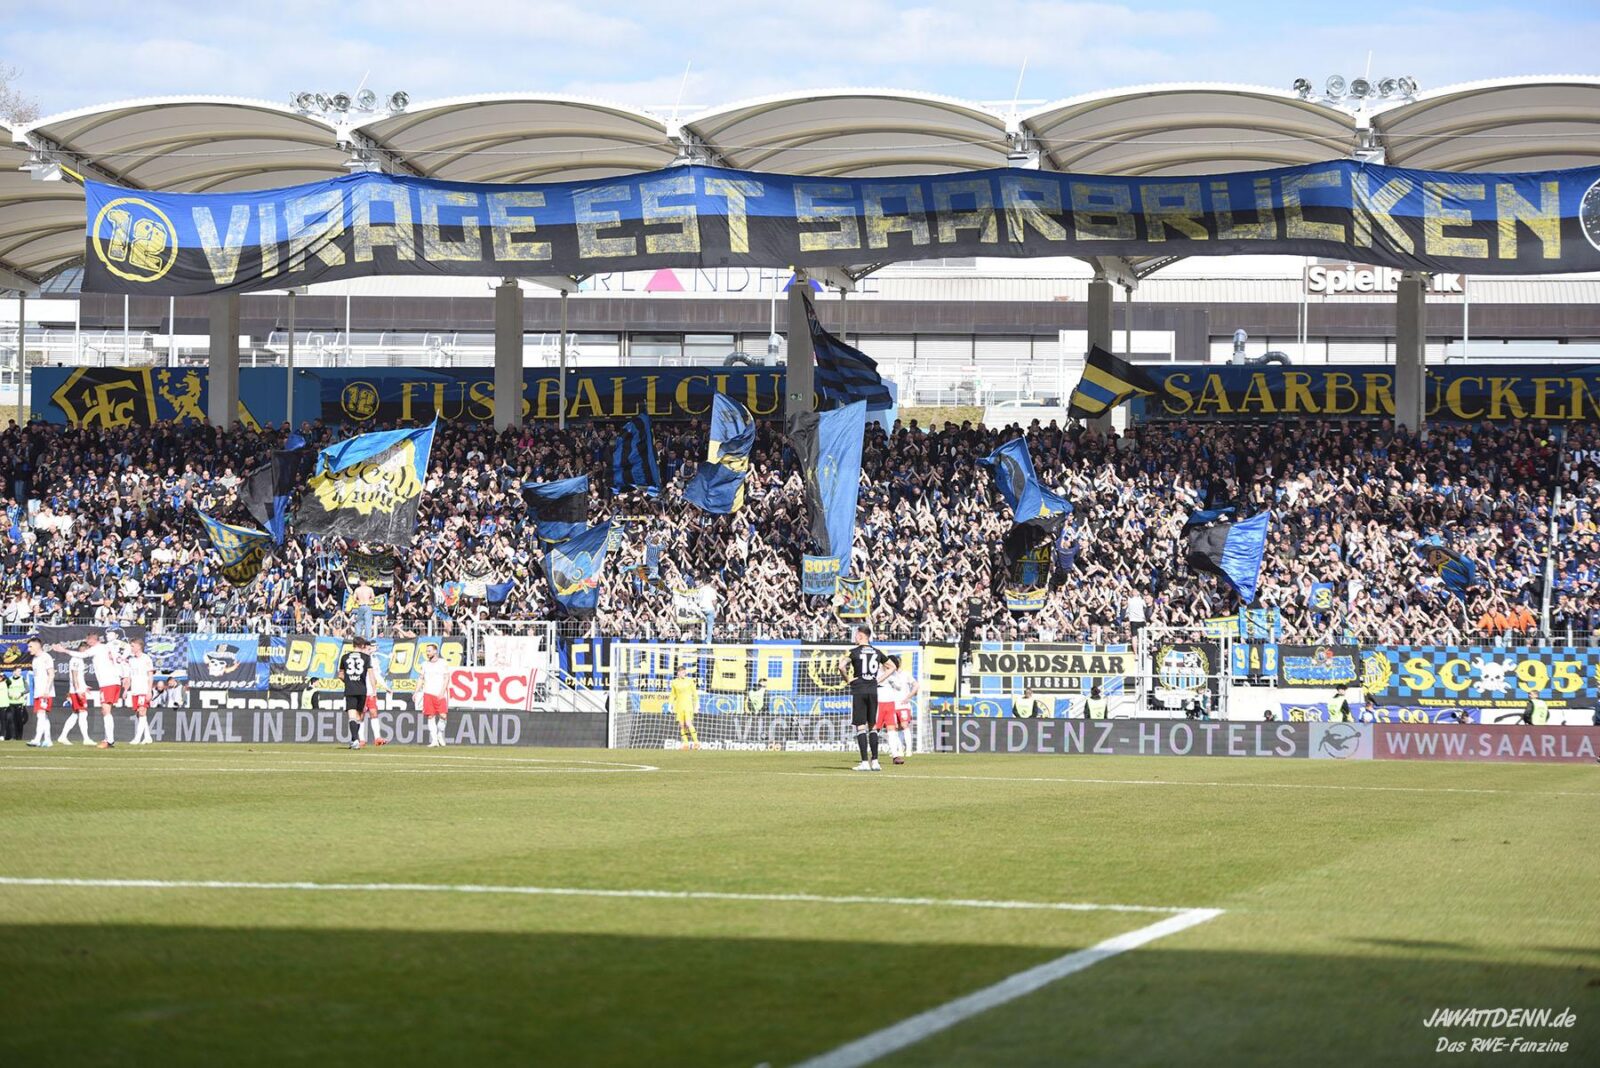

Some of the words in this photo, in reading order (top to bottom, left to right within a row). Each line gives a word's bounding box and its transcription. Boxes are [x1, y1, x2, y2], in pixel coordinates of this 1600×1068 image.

[192, 185, 553, 284] VIRAGE
[573, 176, 764, 258] EST
[793, 169, 1562, 260] SAARBRÜCKEN
[805, 559, 839, 572] BOYS
[346, 658, 364, 675] 33
[859, 653, 878, 674] 16
[978, 652, 1126, 674] NORDSAAR
[1401, 658, 1472, 692] SC
[1515, 659, 1584, 693] 95
[449, 670, 527, 704] SFC
[1027, 677, 1079, 688] JUGEND
[175, 711, 242, 743] MAL
[253, 711, 283, 743] IN
[294, 711, 521, 745] DEUTSCHLAND
[930, 720, 1296, 755] ESIDENZ-HOTELS
